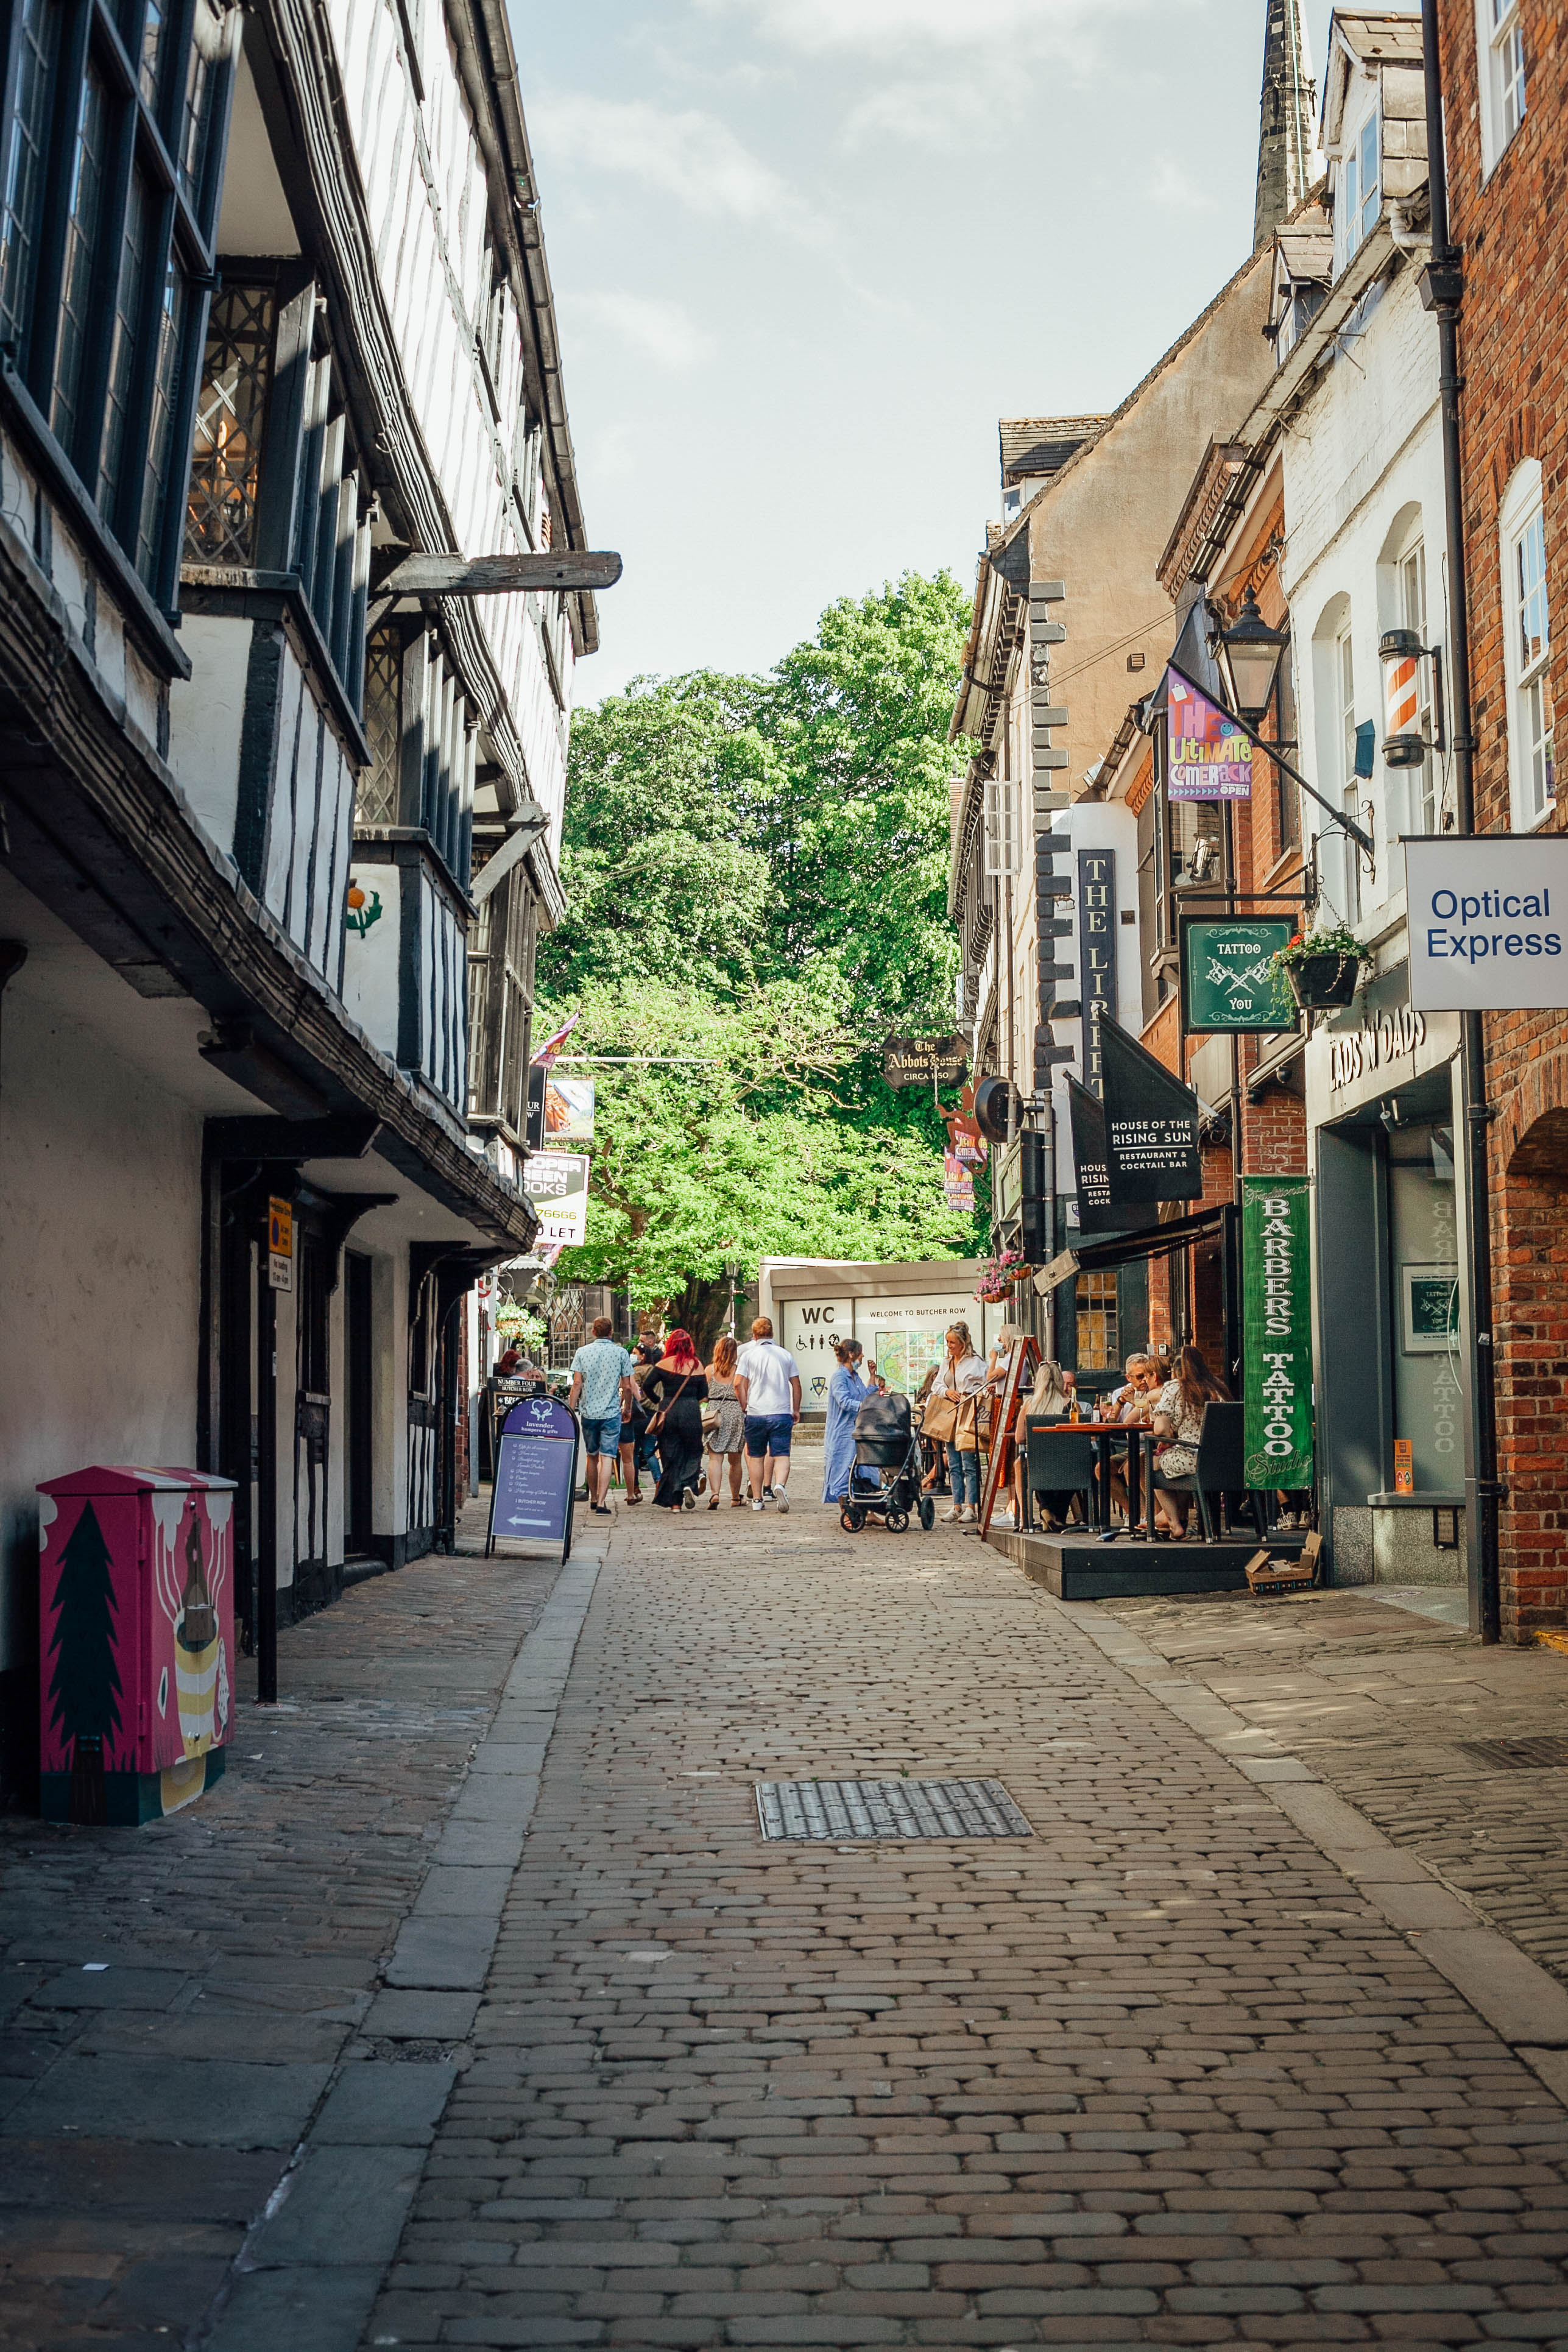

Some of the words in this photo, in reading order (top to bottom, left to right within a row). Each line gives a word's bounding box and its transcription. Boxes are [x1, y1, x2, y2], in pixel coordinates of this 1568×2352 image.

[1168, 693, 1221, 741] THE
[1220, 786, 1249, 796] OPEN
[1085, 860, 1108, 933] THE
[1432, 888, 1550, 926] Optical
[1217, 944, 1262, 954] TATTOO
[1427, 929, 1562, 964] Express
[1229, 997, 1252, 1009] YOU
[914, 1040, 936, 1052] The
[1329, 1031, 1363, 1092] LADS
[1381, 1003, 1425, 1064] DADS
[888, 1053, 928, 1070] Abbots
[1112, 1121, 1148, 1131] HOUSE
[1169, 1120, 1190, 1129] THE
[1112, 1133, 1157, 1145] RISING
[1164, 1132, 1192, 1142] SUN
[1120, 1151, 1178, 1160] RESTAURANT
[1120, 1162, 1166, 1170] COCKTAIL
[550, 1227, 576, 1238] LET
[1260, 1199, 1296, 1336] BARBERS
[802, 1307, 835, 1324] WC
[1262, 1353, 1294, 1456] TATTOO
[1246, 1450, 1313, 1485] Studio
